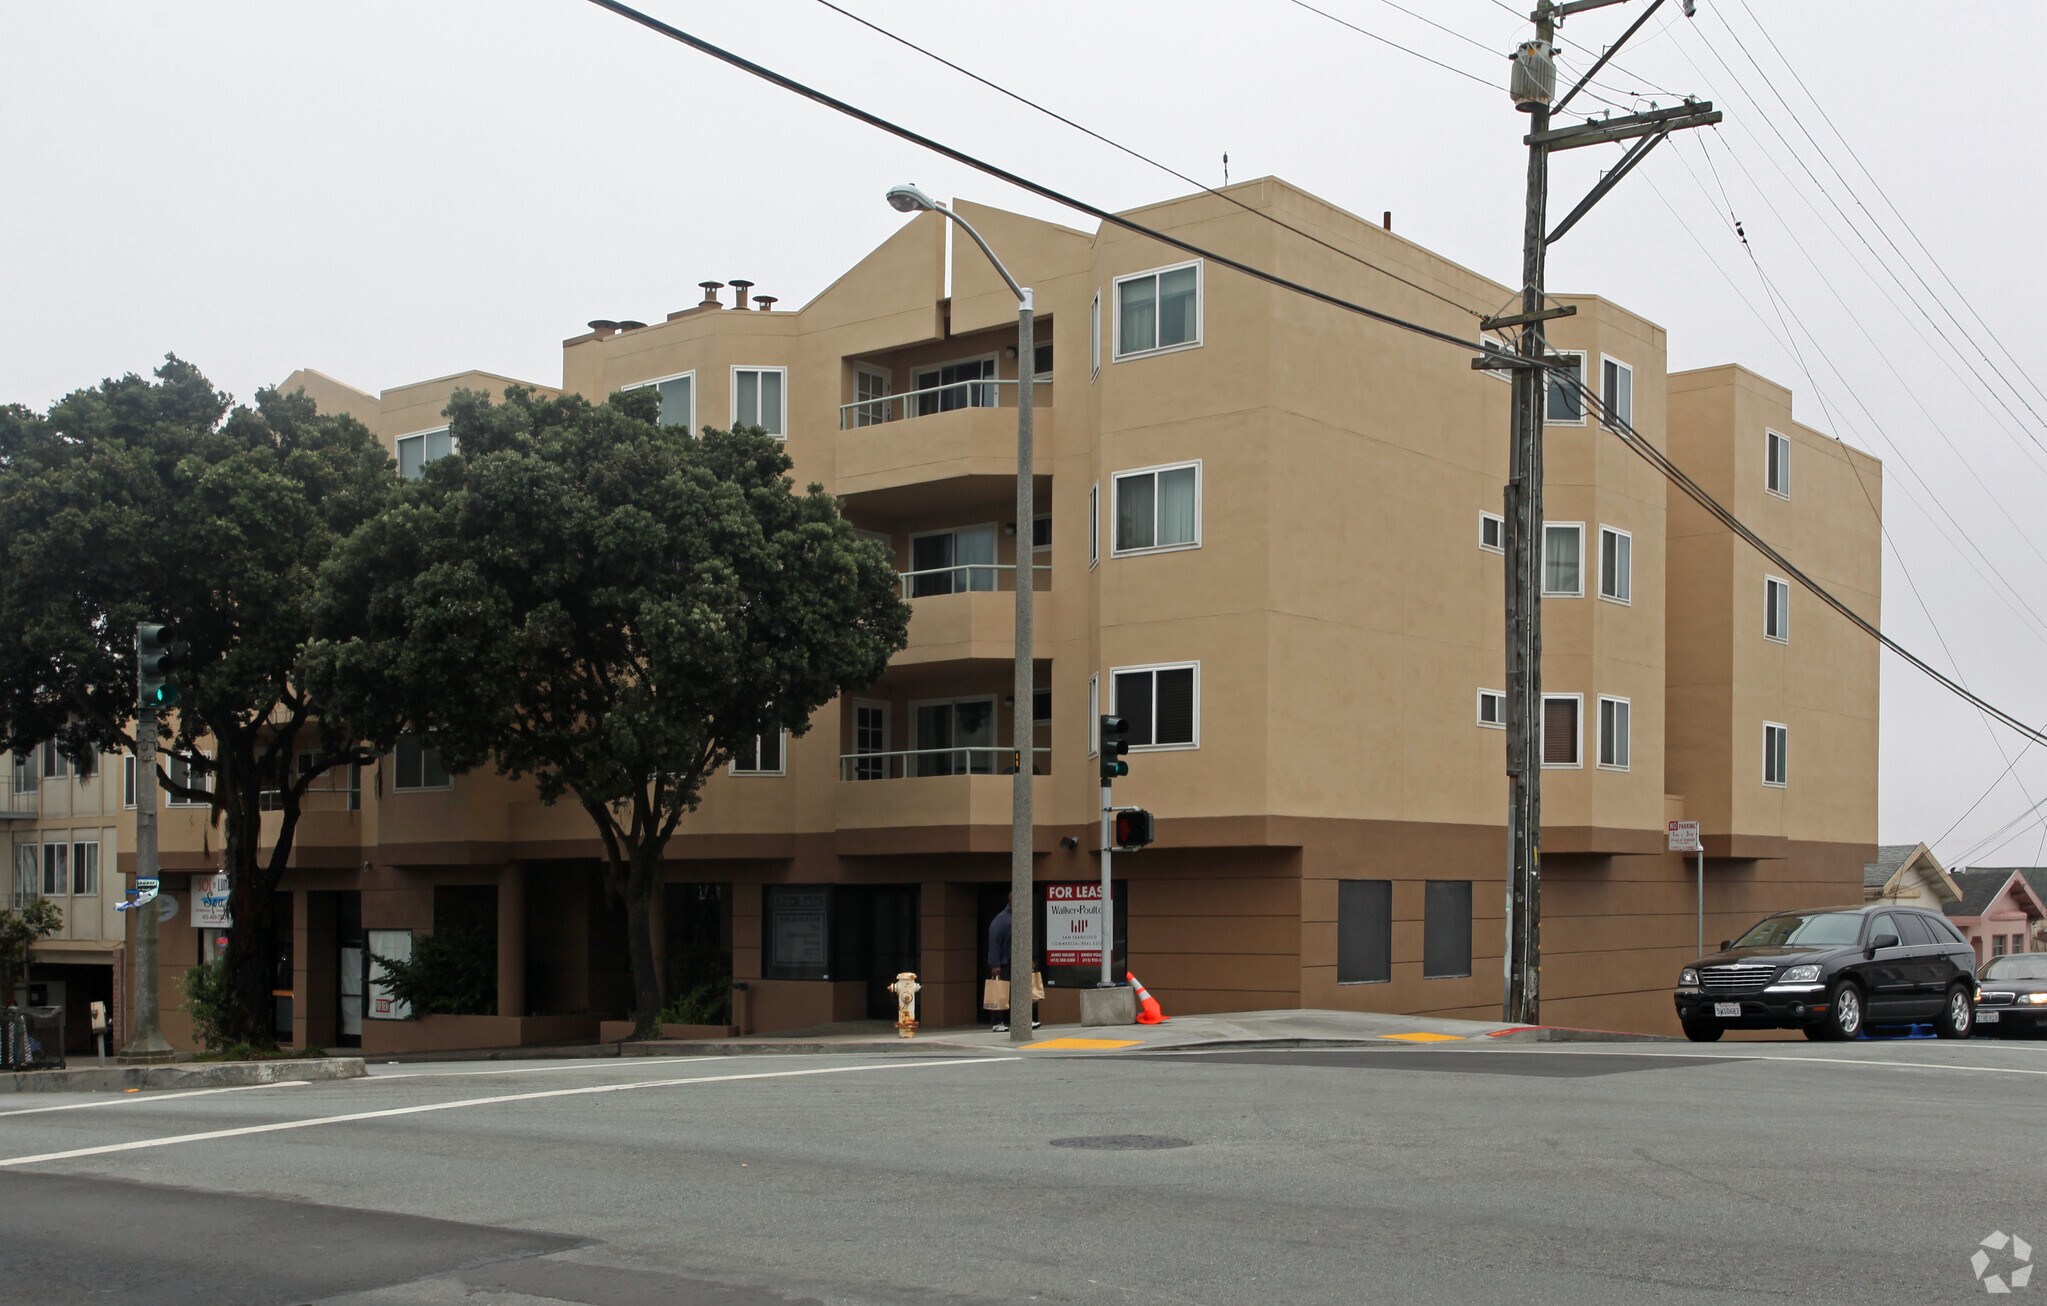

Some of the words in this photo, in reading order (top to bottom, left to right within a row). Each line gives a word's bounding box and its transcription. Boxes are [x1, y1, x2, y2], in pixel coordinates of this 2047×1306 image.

[1670, 822, 1678, 830] NO
[1049, 886, 1073, 899] FOR
[1076, 886, 1102, 898] LEAS
